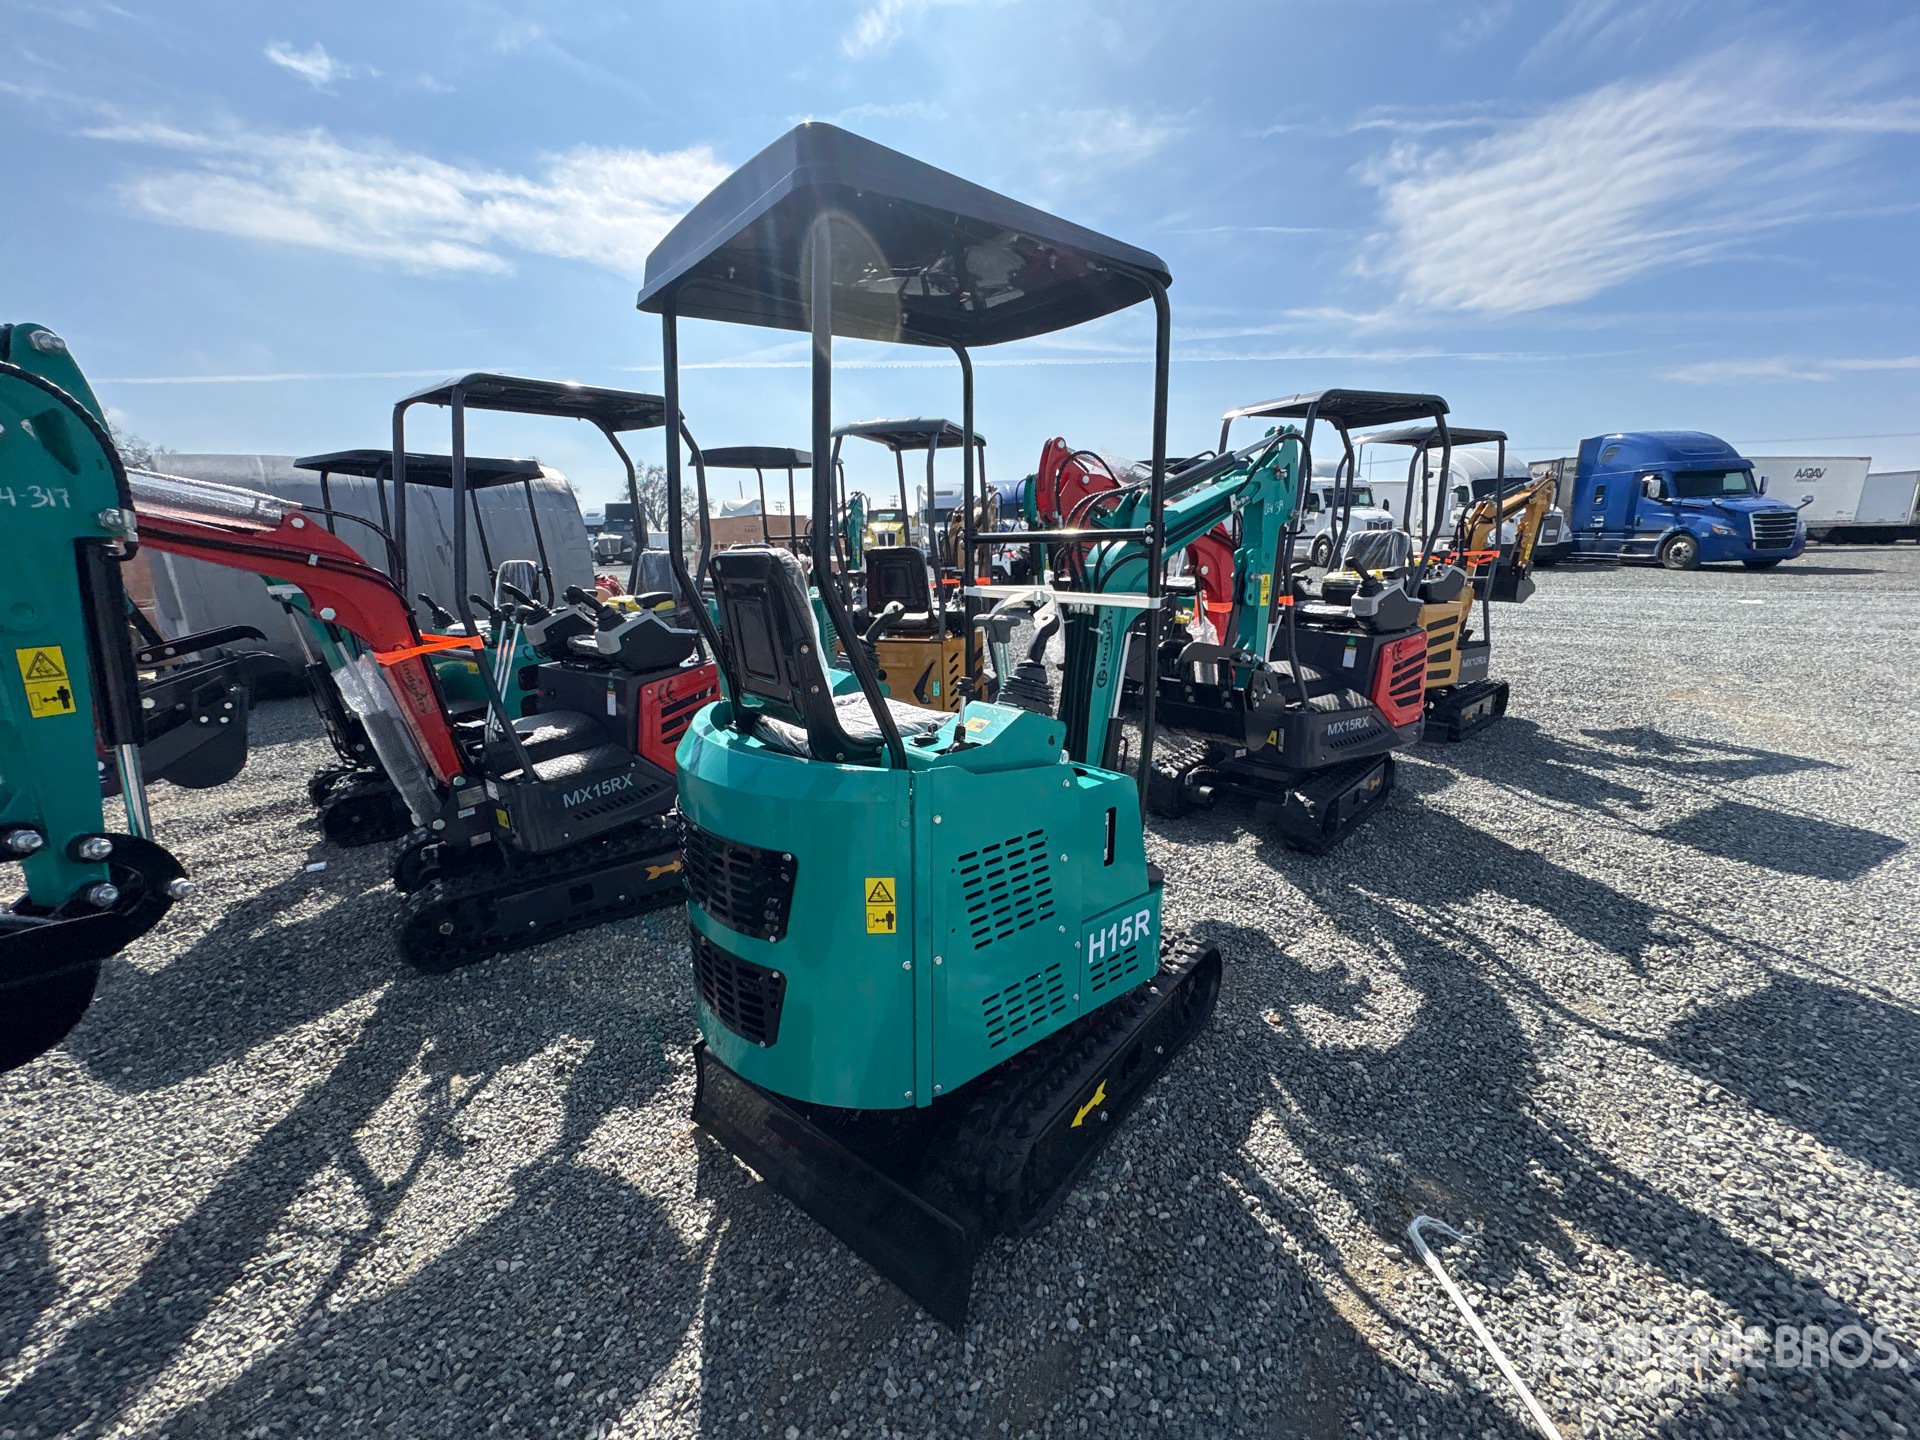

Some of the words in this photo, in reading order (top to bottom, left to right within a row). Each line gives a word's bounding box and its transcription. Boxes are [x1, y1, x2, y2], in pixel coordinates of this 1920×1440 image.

[1326, 715, 1370, 737] MX15RX
[562, 772, 634, 809] MX15RX
[1088, 908, 1151, 965] H15R
